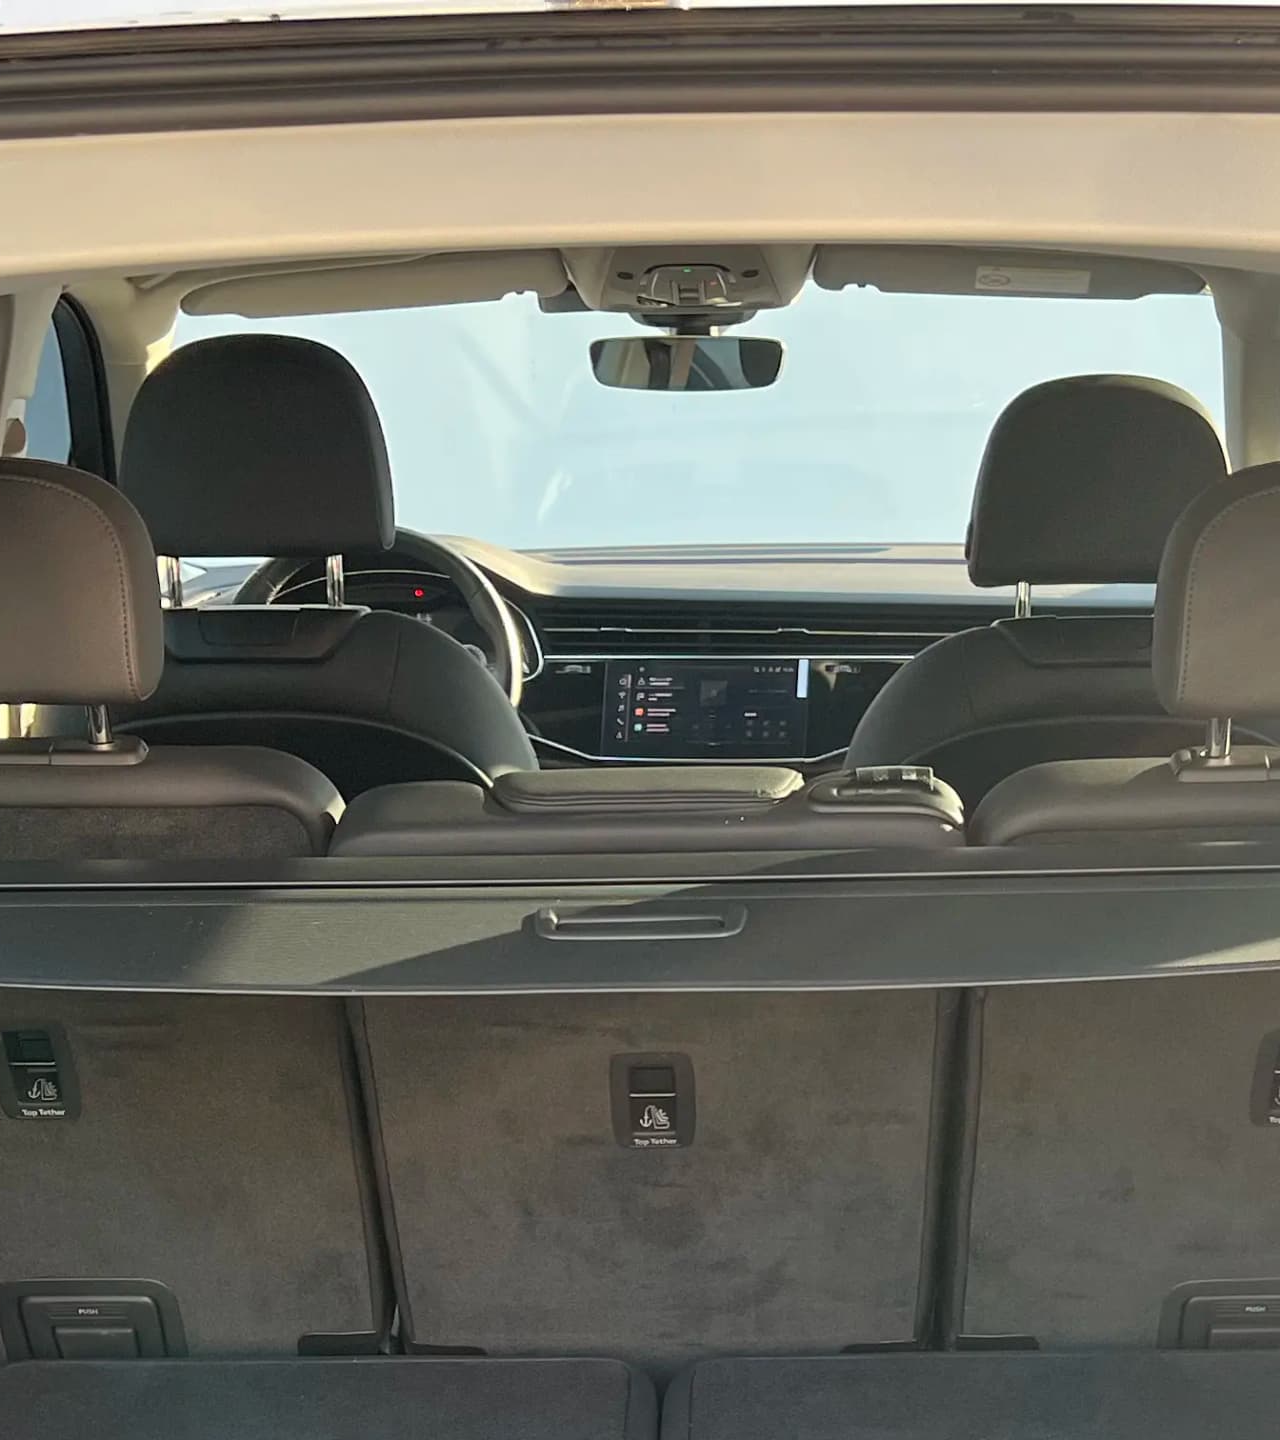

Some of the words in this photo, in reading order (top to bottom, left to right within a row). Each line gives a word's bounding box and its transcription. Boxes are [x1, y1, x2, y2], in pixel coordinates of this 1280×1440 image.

[21, 1109, 38, 1117] Top
[39, 1108, 66, 1116] Tether
[633, 1138, 650, 1146] Top
